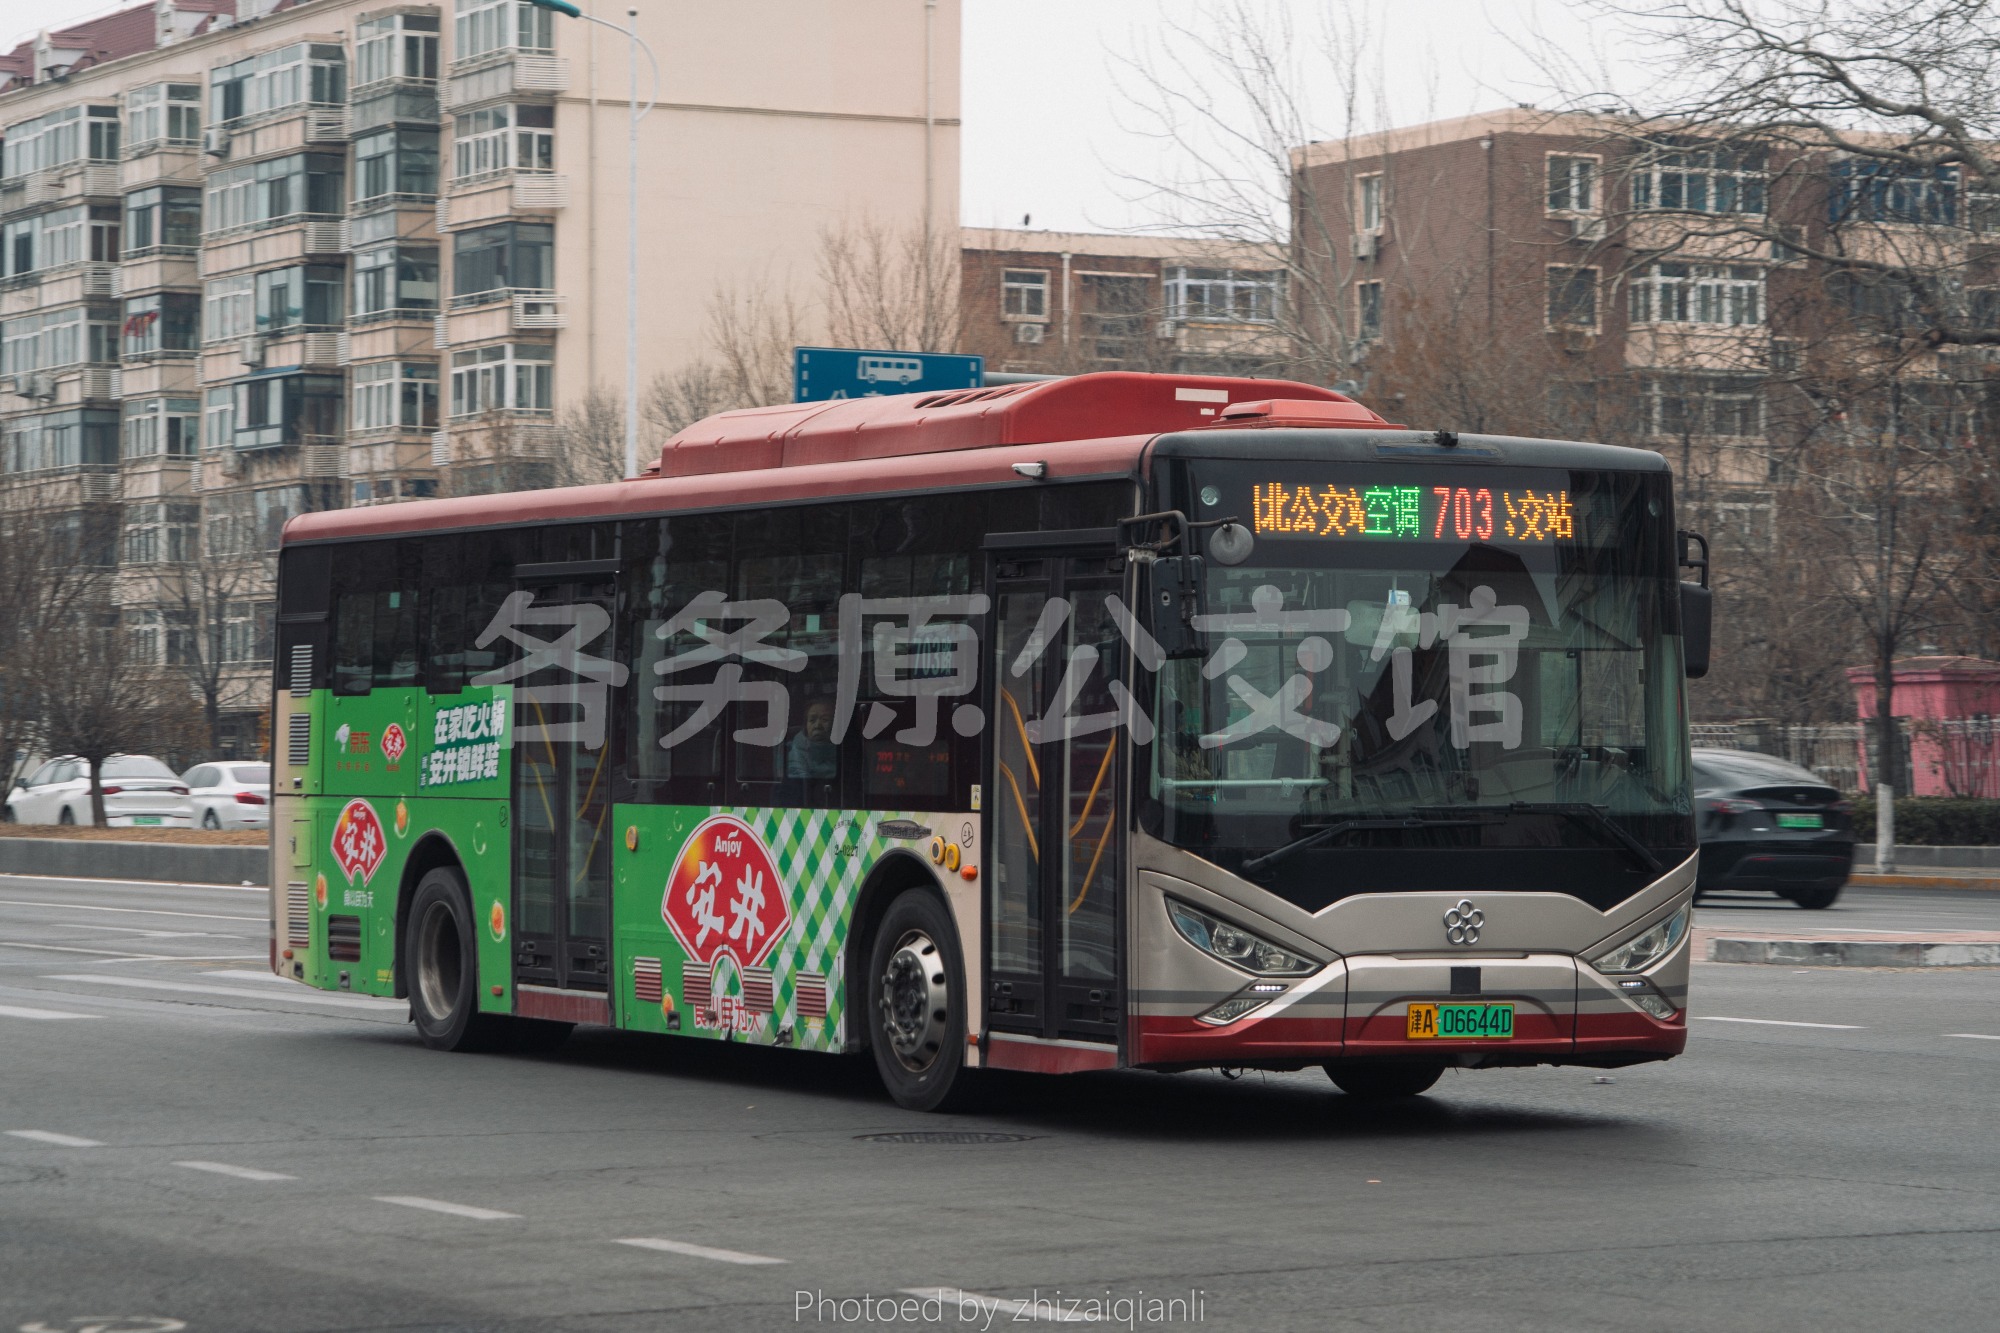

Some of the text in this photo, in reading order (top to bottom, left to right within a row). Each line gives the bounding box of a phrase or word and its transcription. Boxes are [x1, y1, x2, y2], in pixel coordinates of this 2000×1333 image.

[1364, 485, 1420, 537] 空调
[1433, 487, 1492, 540] 703
[351, 732, 371, 753] 京东
[435, 699, 506, 745] 在家吃火锅
[429, 742, 500, 785] 安井锁鲜装
[341, 822, 377, 867] 安井
[715, 831, 742, 858] Anjoy
[686, 860, 765, 954] 安井
